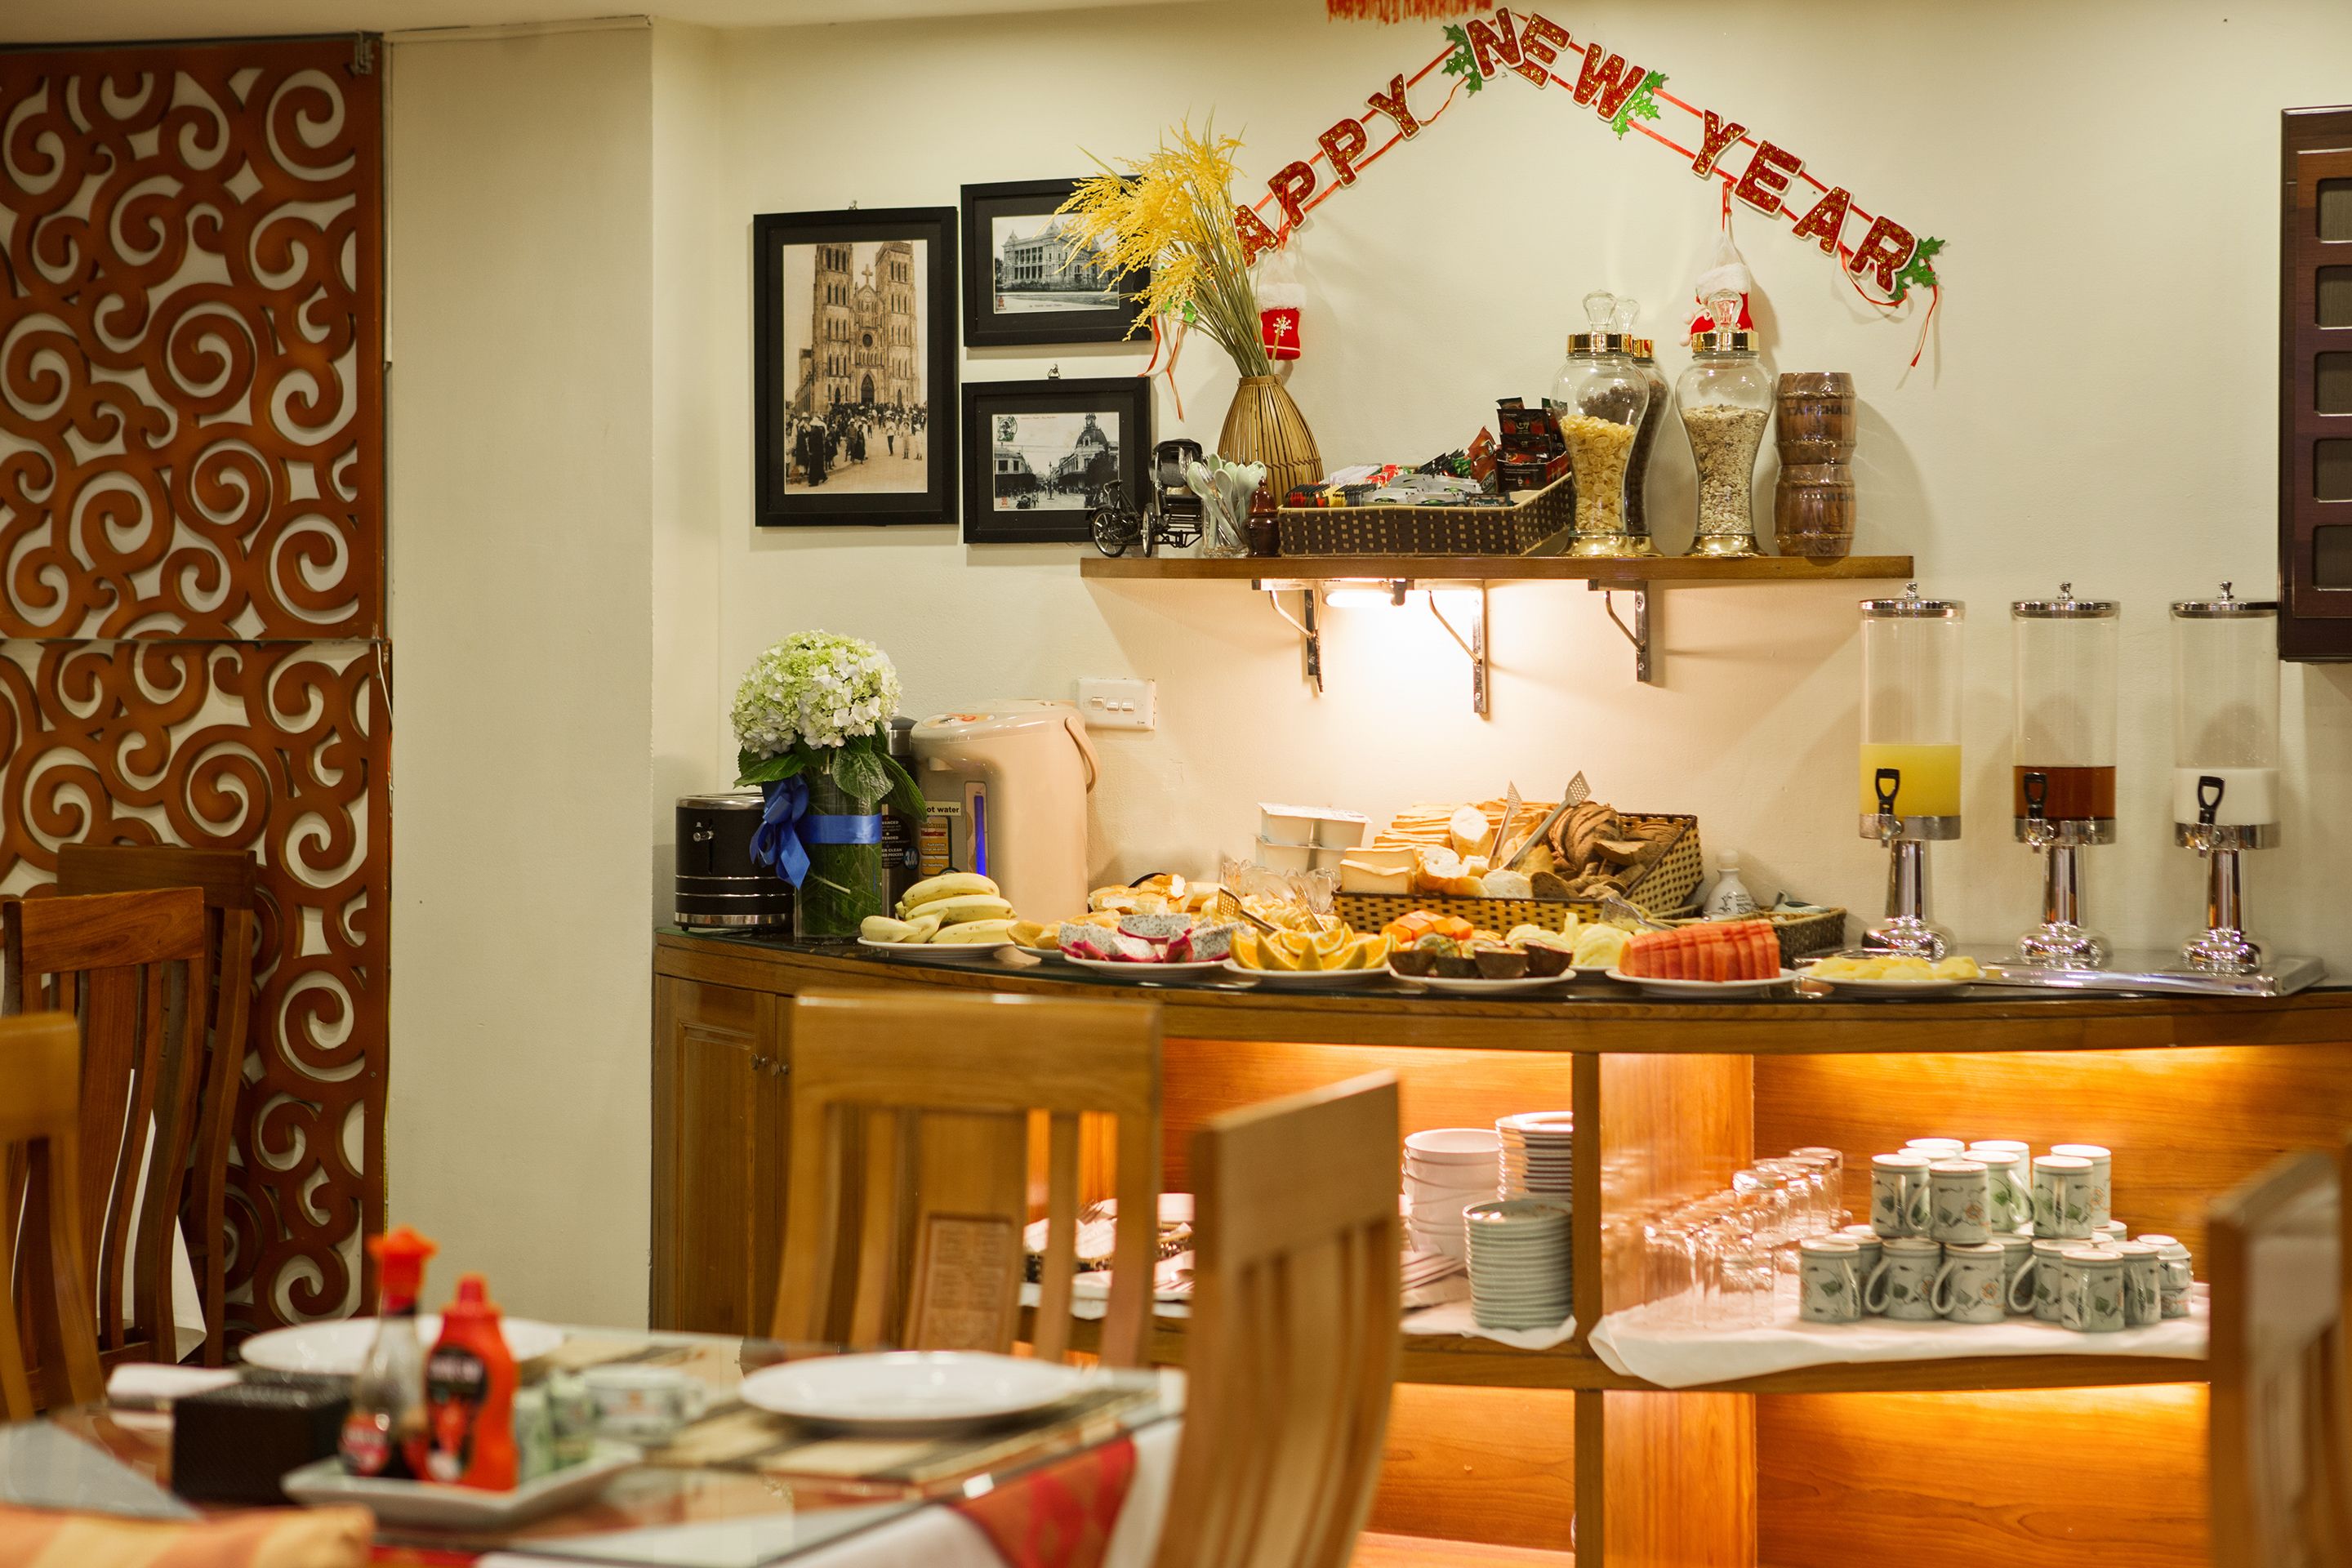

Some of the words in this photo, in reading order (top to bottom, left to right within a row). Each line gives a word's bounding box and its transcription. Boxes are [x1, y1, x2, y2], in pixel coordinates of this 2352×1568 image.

[1234, 73, 1421, 268] APPY
[1463, 7, 1648, 122] NEW
[1692, 109, 1918, 296] YEAR
